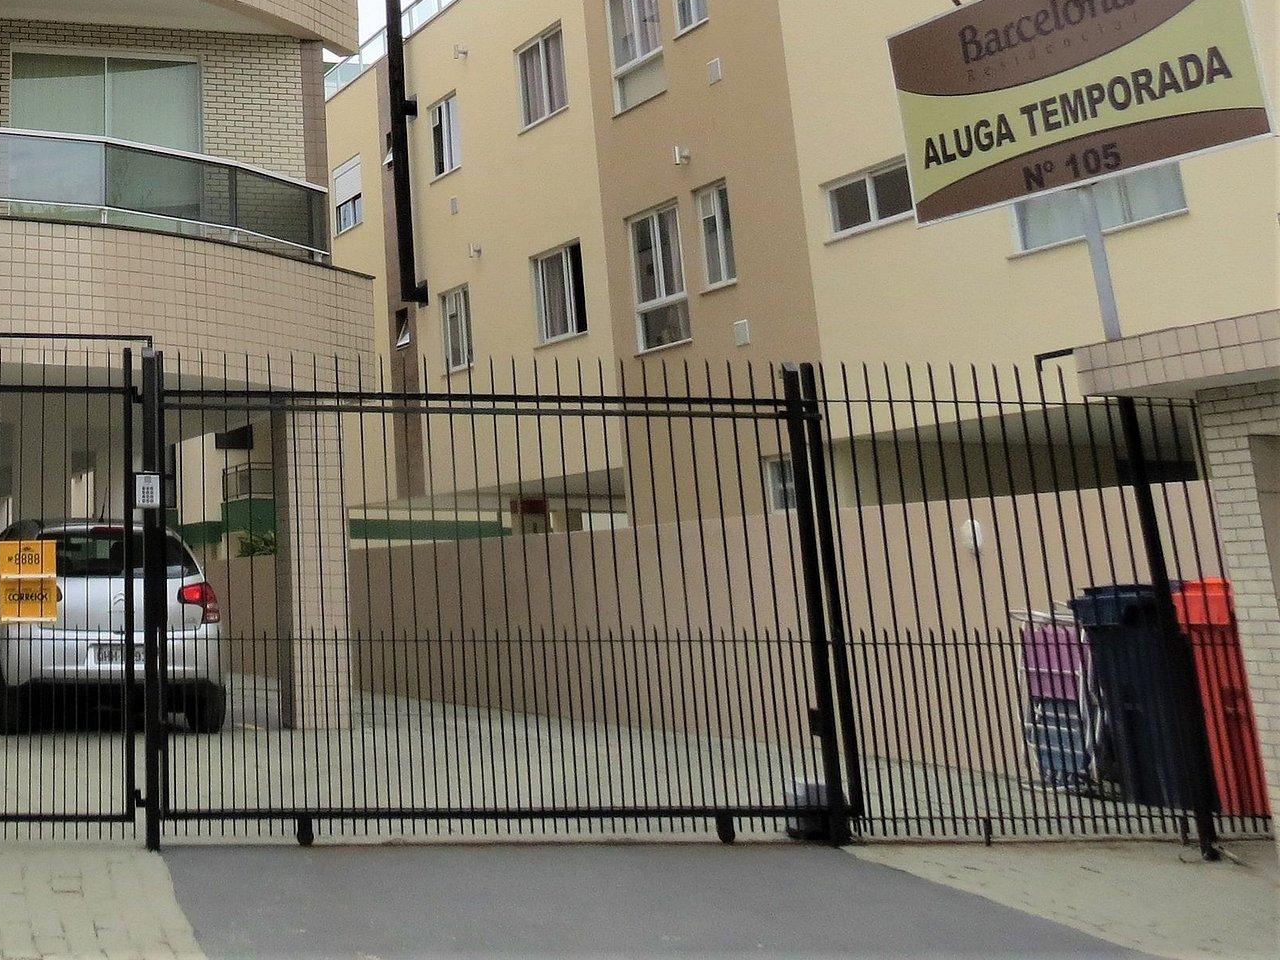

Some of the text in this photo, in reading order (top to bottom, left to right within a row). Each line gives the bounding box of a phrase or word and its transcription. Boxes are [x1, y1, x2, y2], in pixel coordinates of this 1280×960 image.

[923, 45, 1234, 170] ALUGA TEMPORADA
[1065, 141, 1122, 179] 105
